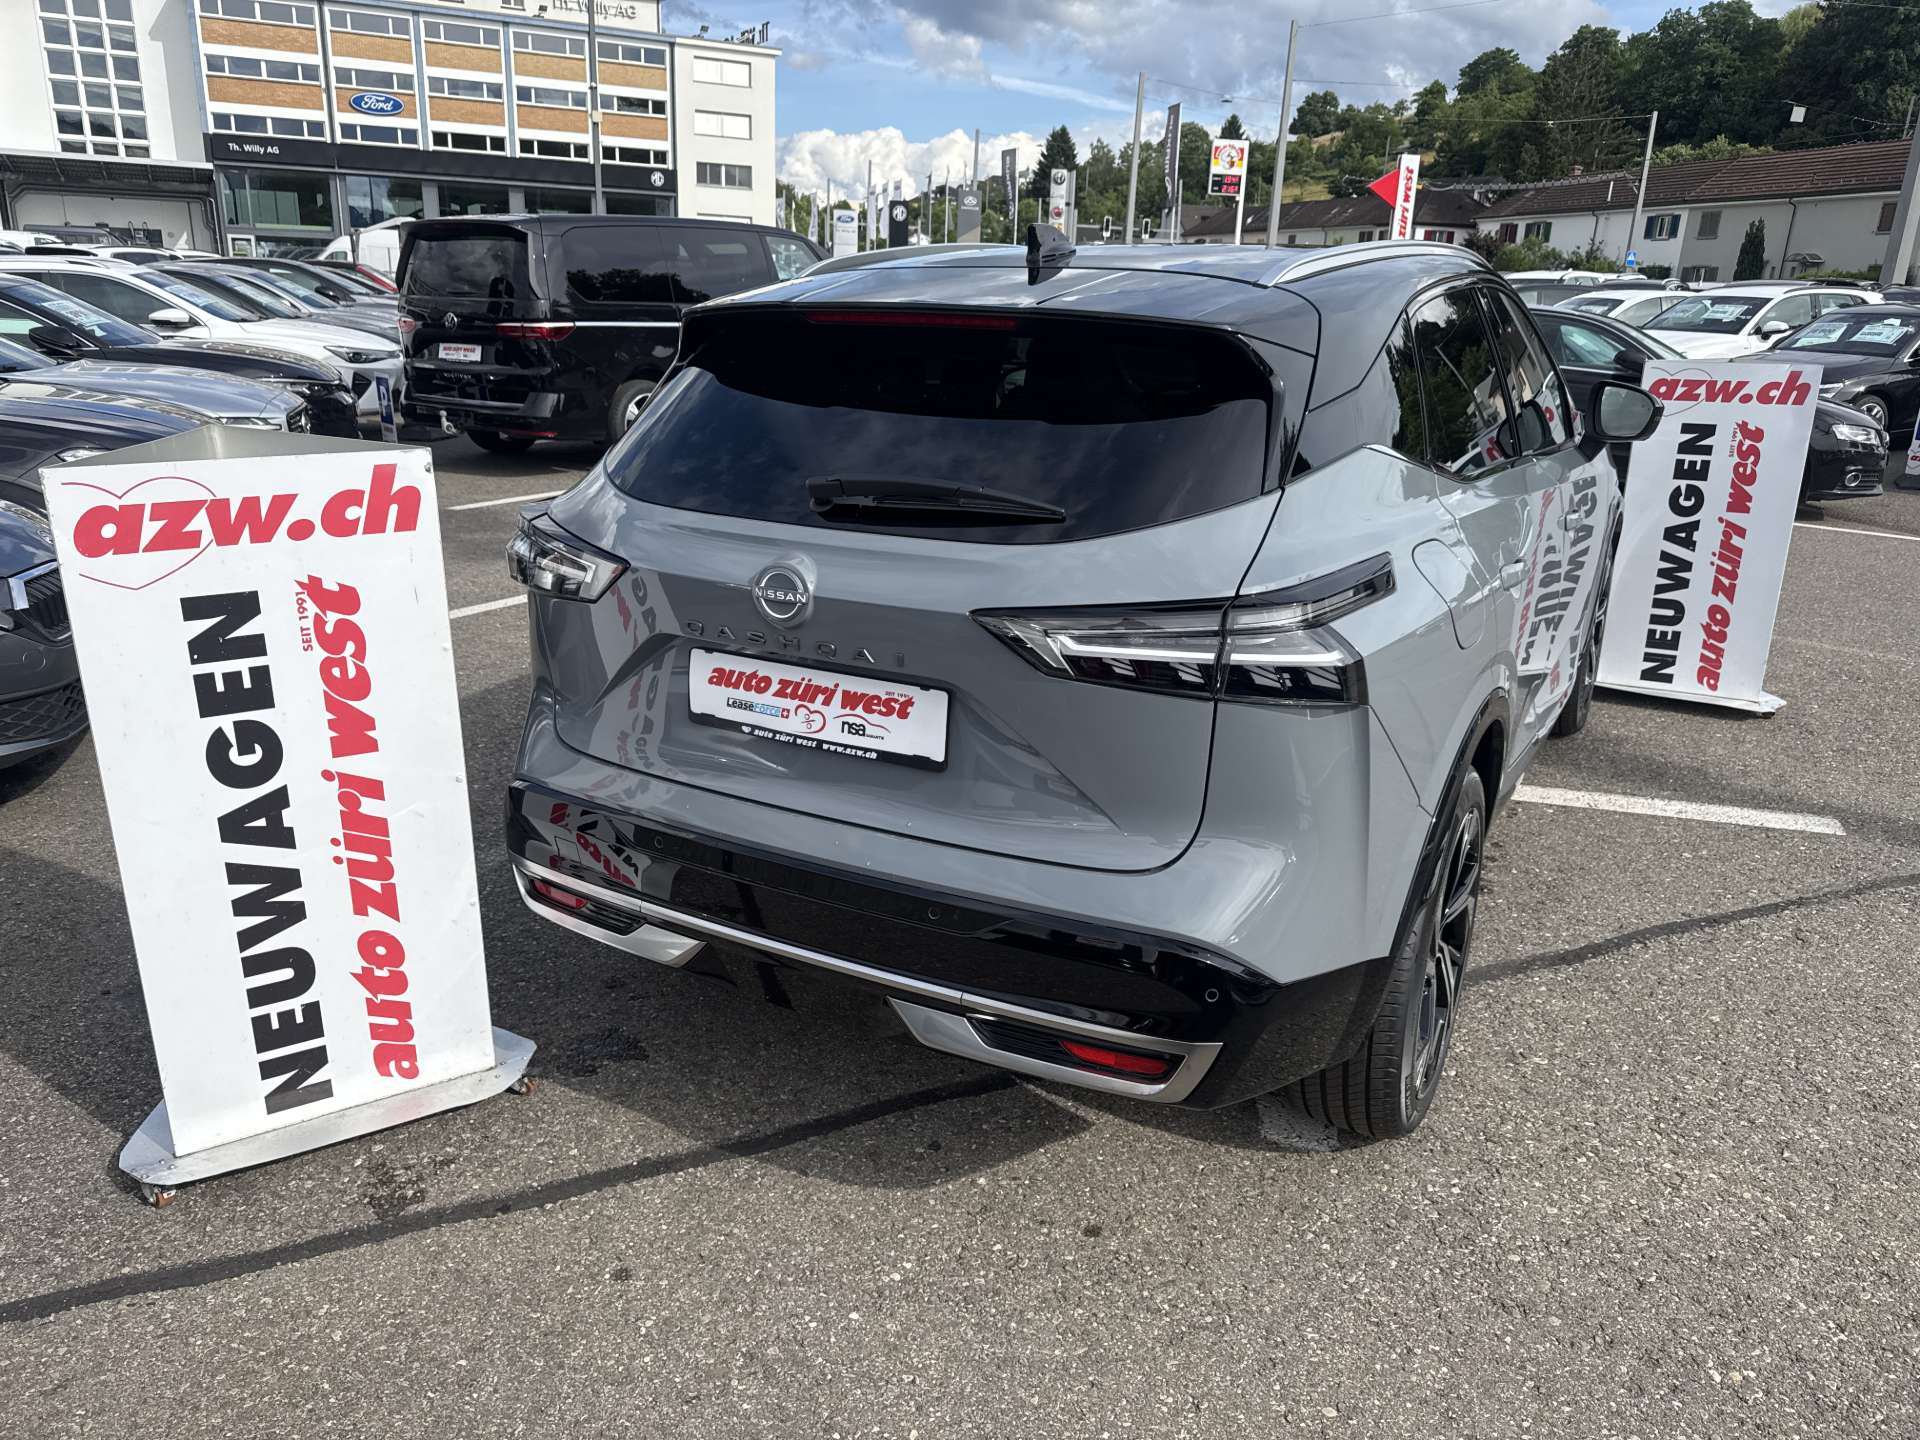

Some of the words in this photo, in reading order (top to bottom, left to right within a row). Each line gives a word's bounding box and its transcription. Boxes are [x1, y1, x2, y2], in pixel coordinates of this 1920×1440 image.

[615, 3, 637, 19] AG
[361, 95, 394, 110] Ford
[227, 142, 242, 152] Th.
[242, 143, 265, 155] Willy
[266, 145, 280, 154] AG
[1403, 166, 1414, 203] west
[1648, 370, 1812, 406] azw.ch
[1726, 420, 1765, 514] west
[73, 464, 422, 558] azw.ch
[1640, 422, 1718, 684] NEUWAGEN
[1709, 516, 1747, 605] züri
[295, 591, 309, 621] 1991
[755, 587, 806, 602] NISSAN
[300, 626, 313, 652] SEIT
[688, 619, 905, 668] QASHQAI
[1696, 603, 1731, 692] auto
[294, 574, 379, 758] west
[708, 667, 772, 694] auto
[772, 677, 839, 706] züri
[841, 689, 914, 720] west
[754, 728, 773, 739] auto
[796, 738, 817, 748] west
[822, 743, 878, 760] www.azw.ch
[841, 720, 866, 737] nsa
[180, 590, 334, 1115] NEUWAGEN
[321, 769, 401, 923] züri
[349, 929, 420, 1080] auto
